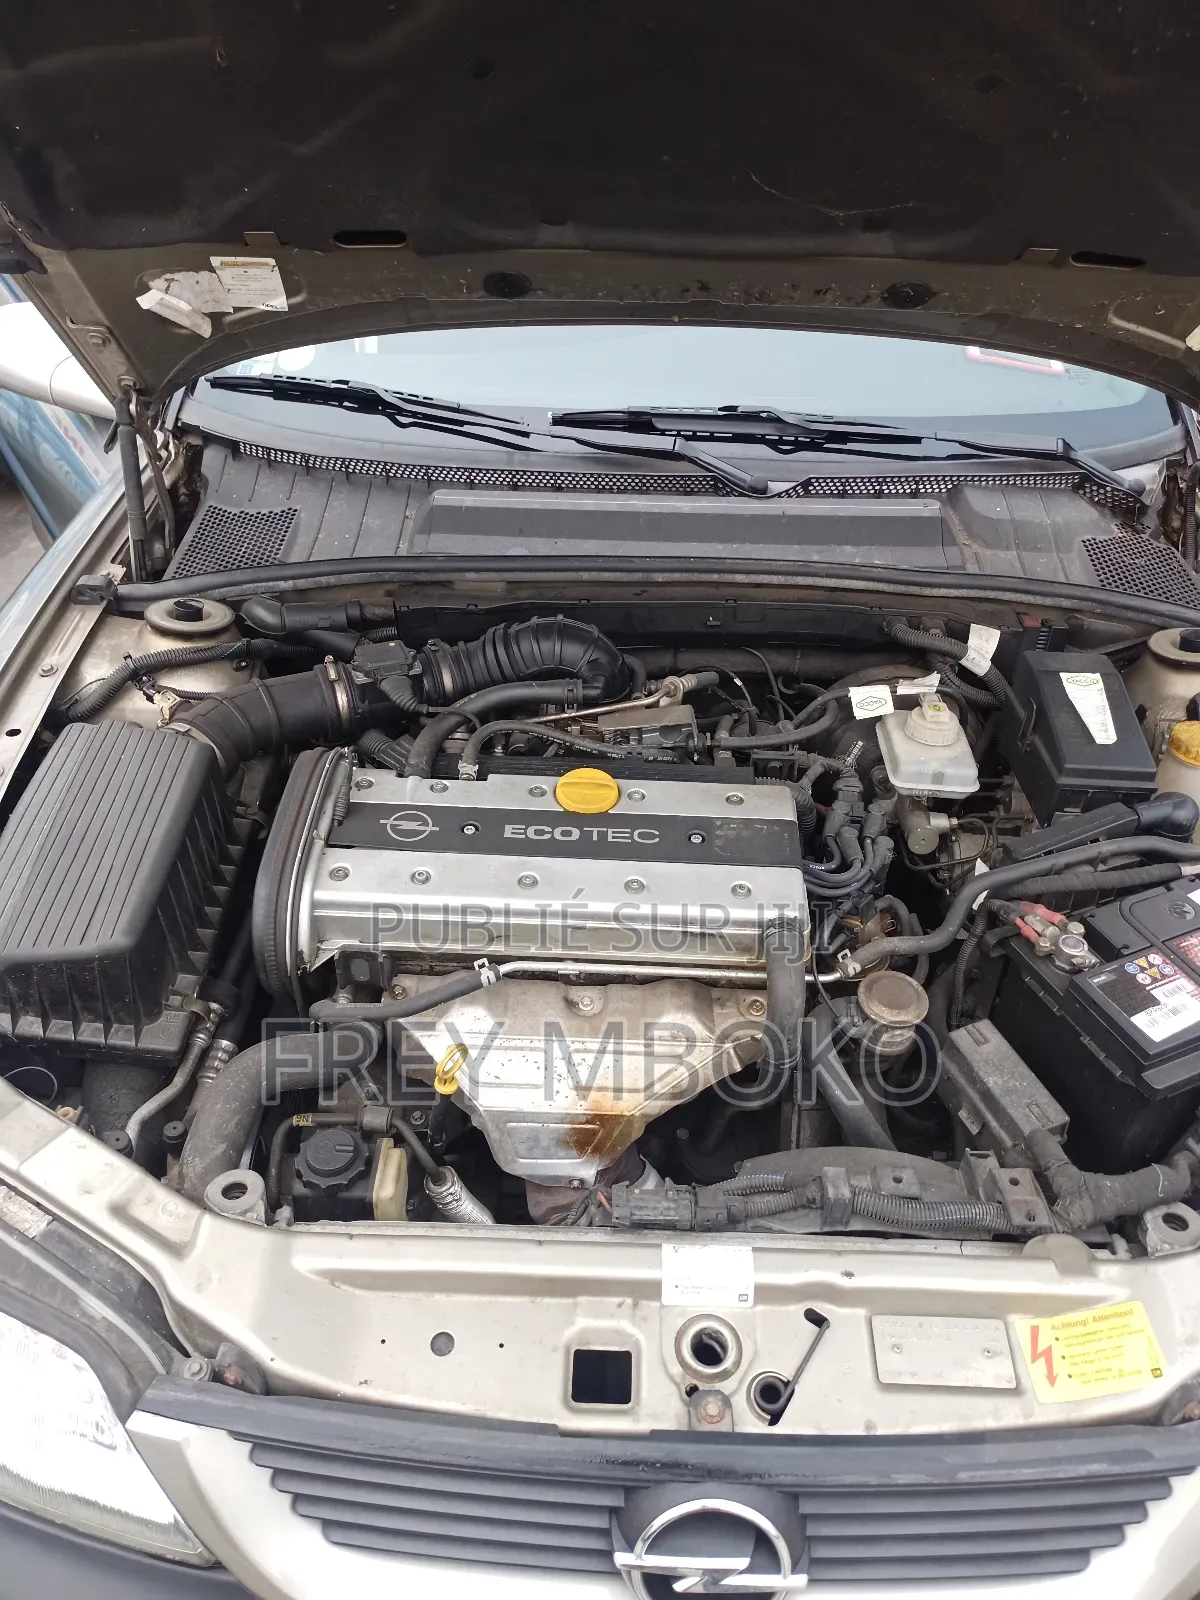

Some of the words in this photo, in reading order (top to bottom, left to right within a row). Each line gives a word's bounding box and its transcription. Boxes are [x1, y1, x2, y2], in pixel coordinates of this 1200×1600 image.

[859, 699, 883, 708] YACCO
[503, 824, 660, 844] ECOTEC
[1050, 1317, 1090, 1331] Achtung!
[1092, 1308, 1134, 1324] Attention!
